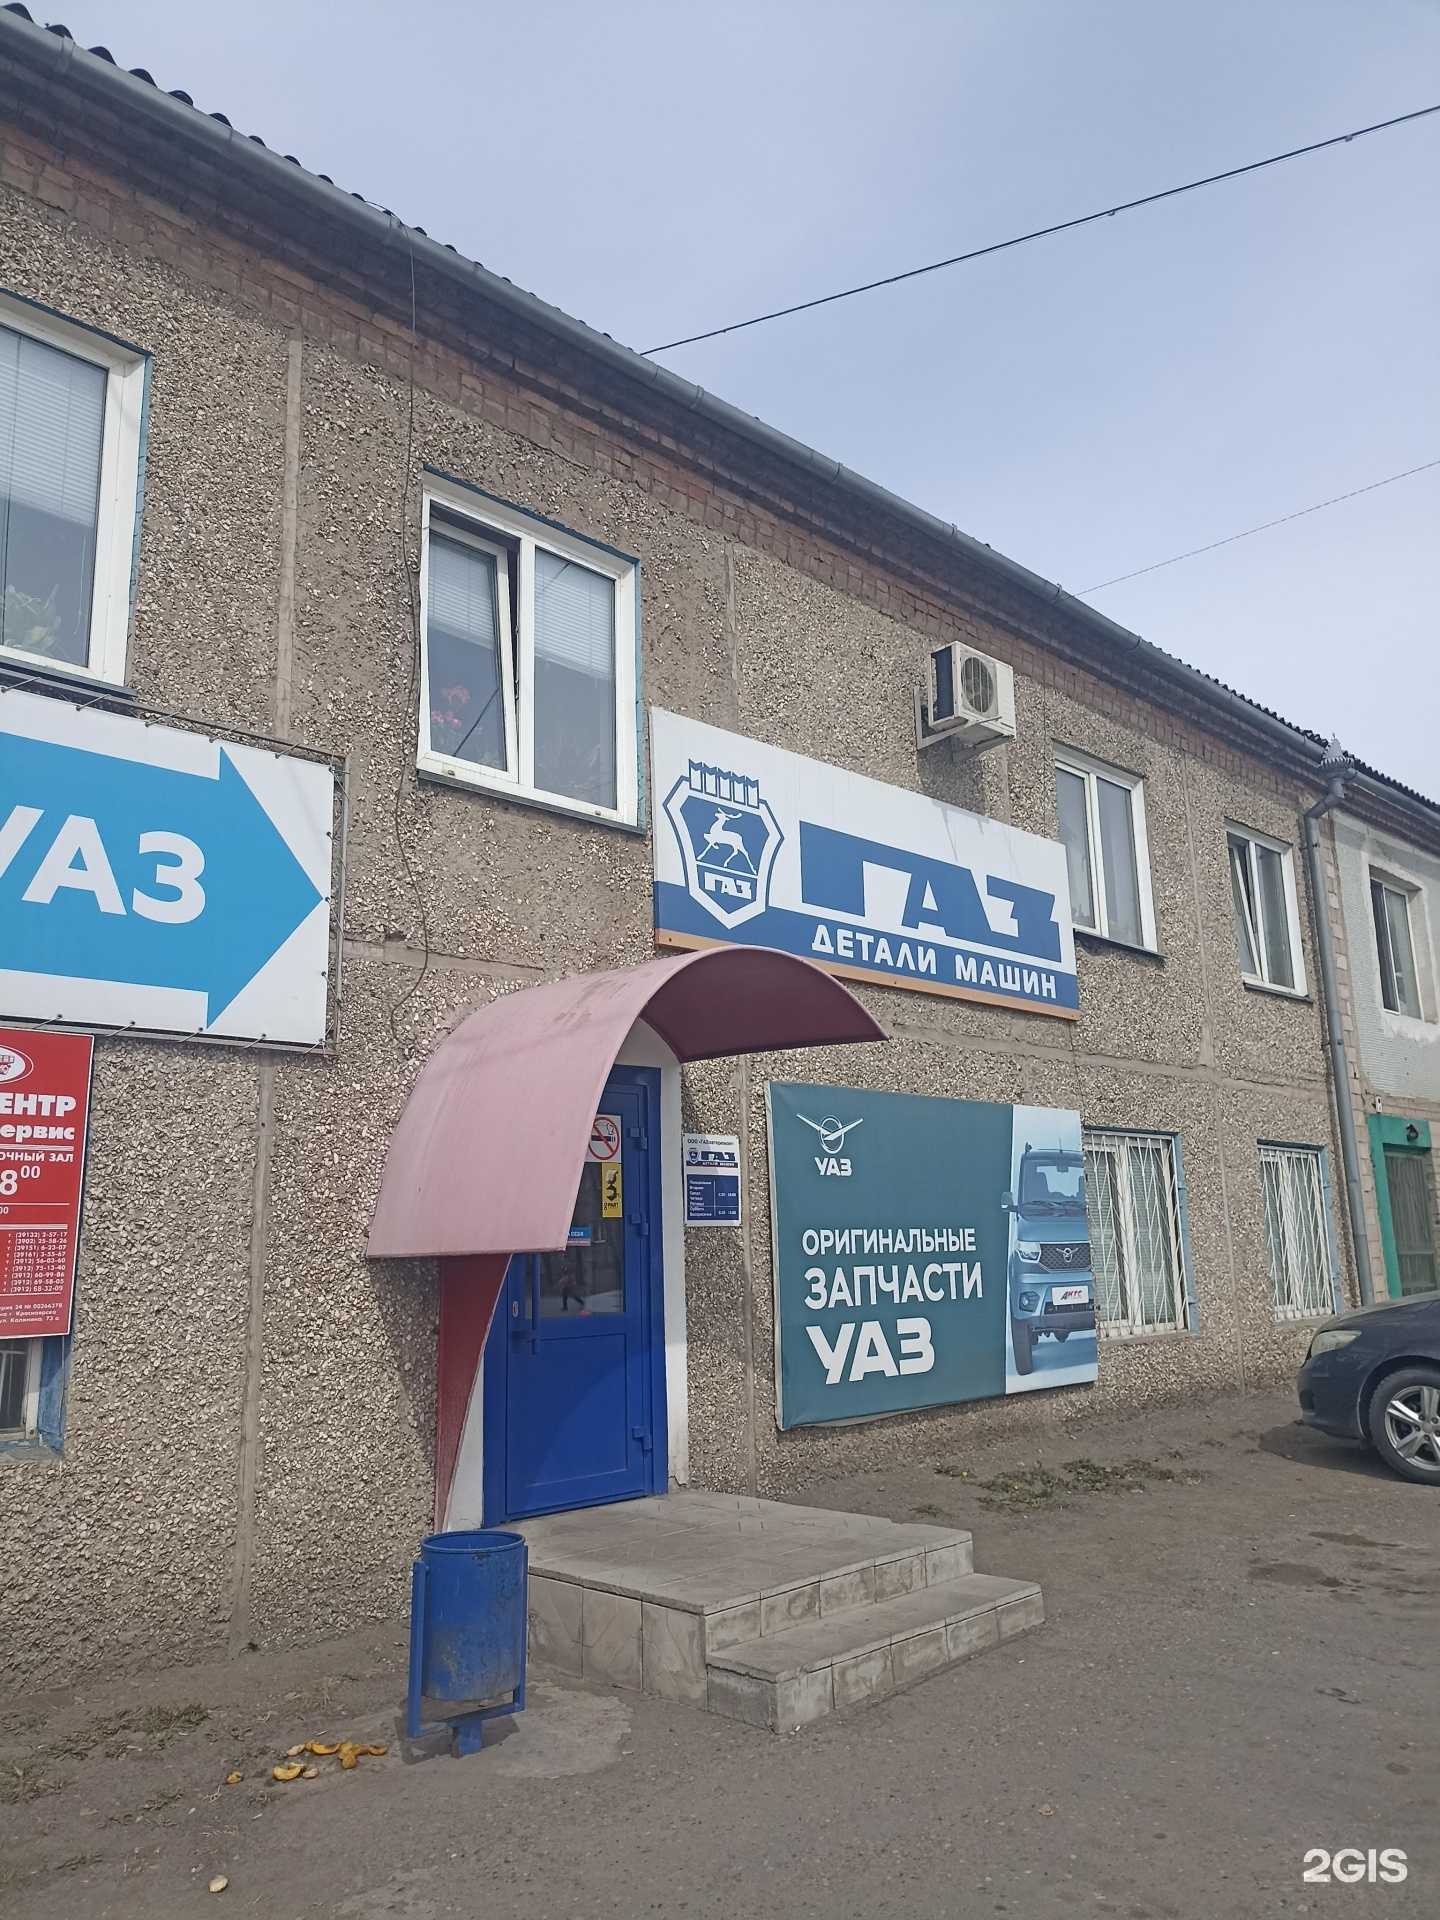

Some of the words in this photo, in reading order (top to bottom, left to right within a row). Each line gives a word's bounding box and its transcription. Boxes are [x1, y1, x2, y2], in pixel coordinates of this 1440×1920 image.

[704, 871, 752, 900] ГАЗ
[800, 820, 1062, 963] ГАЗ
[811, 924, 937, 975] ДЕТАЛИ
[954, 954, 1057, 999] МАШИН
[48, 1153, 73, 1163] ЗАЛ
[814, 1157, 852, 1176] УАЗ
[802, 1228, 977, 1255] ОРИГИНАЛЬНЫЕ
[804, 1262, 983, 1310] ЗАПЧАСТИ
[805, 1317, 935, 1385] УАЗ
